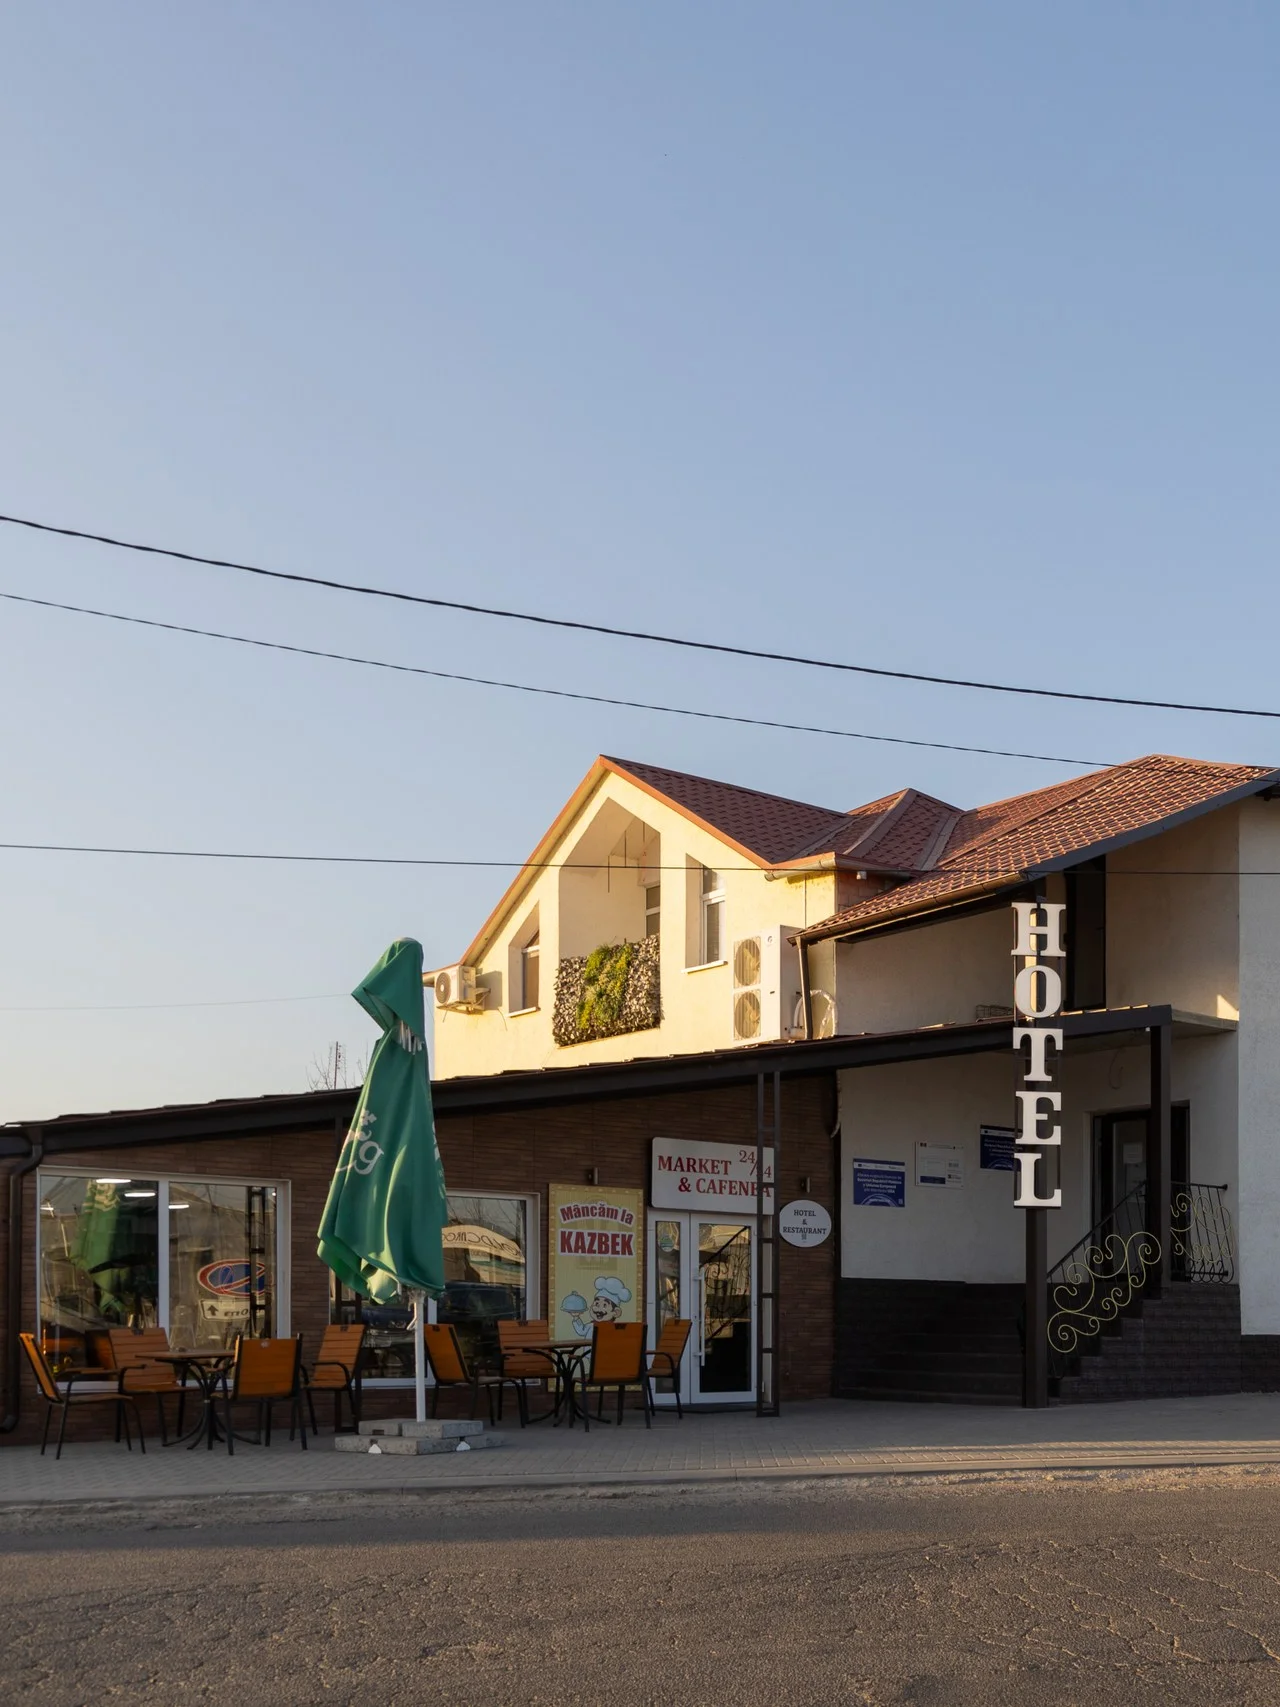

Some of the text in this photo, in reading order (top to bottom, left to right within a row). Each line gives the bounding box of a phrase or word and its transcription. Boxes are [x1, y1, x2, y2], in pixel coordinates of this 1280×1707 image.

[1011, 902, 1067, 1208] HOTEL
[657, 1150, 772, 1178] MARKET 24/4
[678, 1177, 692, 1193] &
[560, 1203, 634, 1225] Mâncăm la
[793, 1209, 817, 1217] HOTEL
[783, 1226, 827, 1235] RESTAURANT
[560, 1231, 634, 1256] KAZBEK
